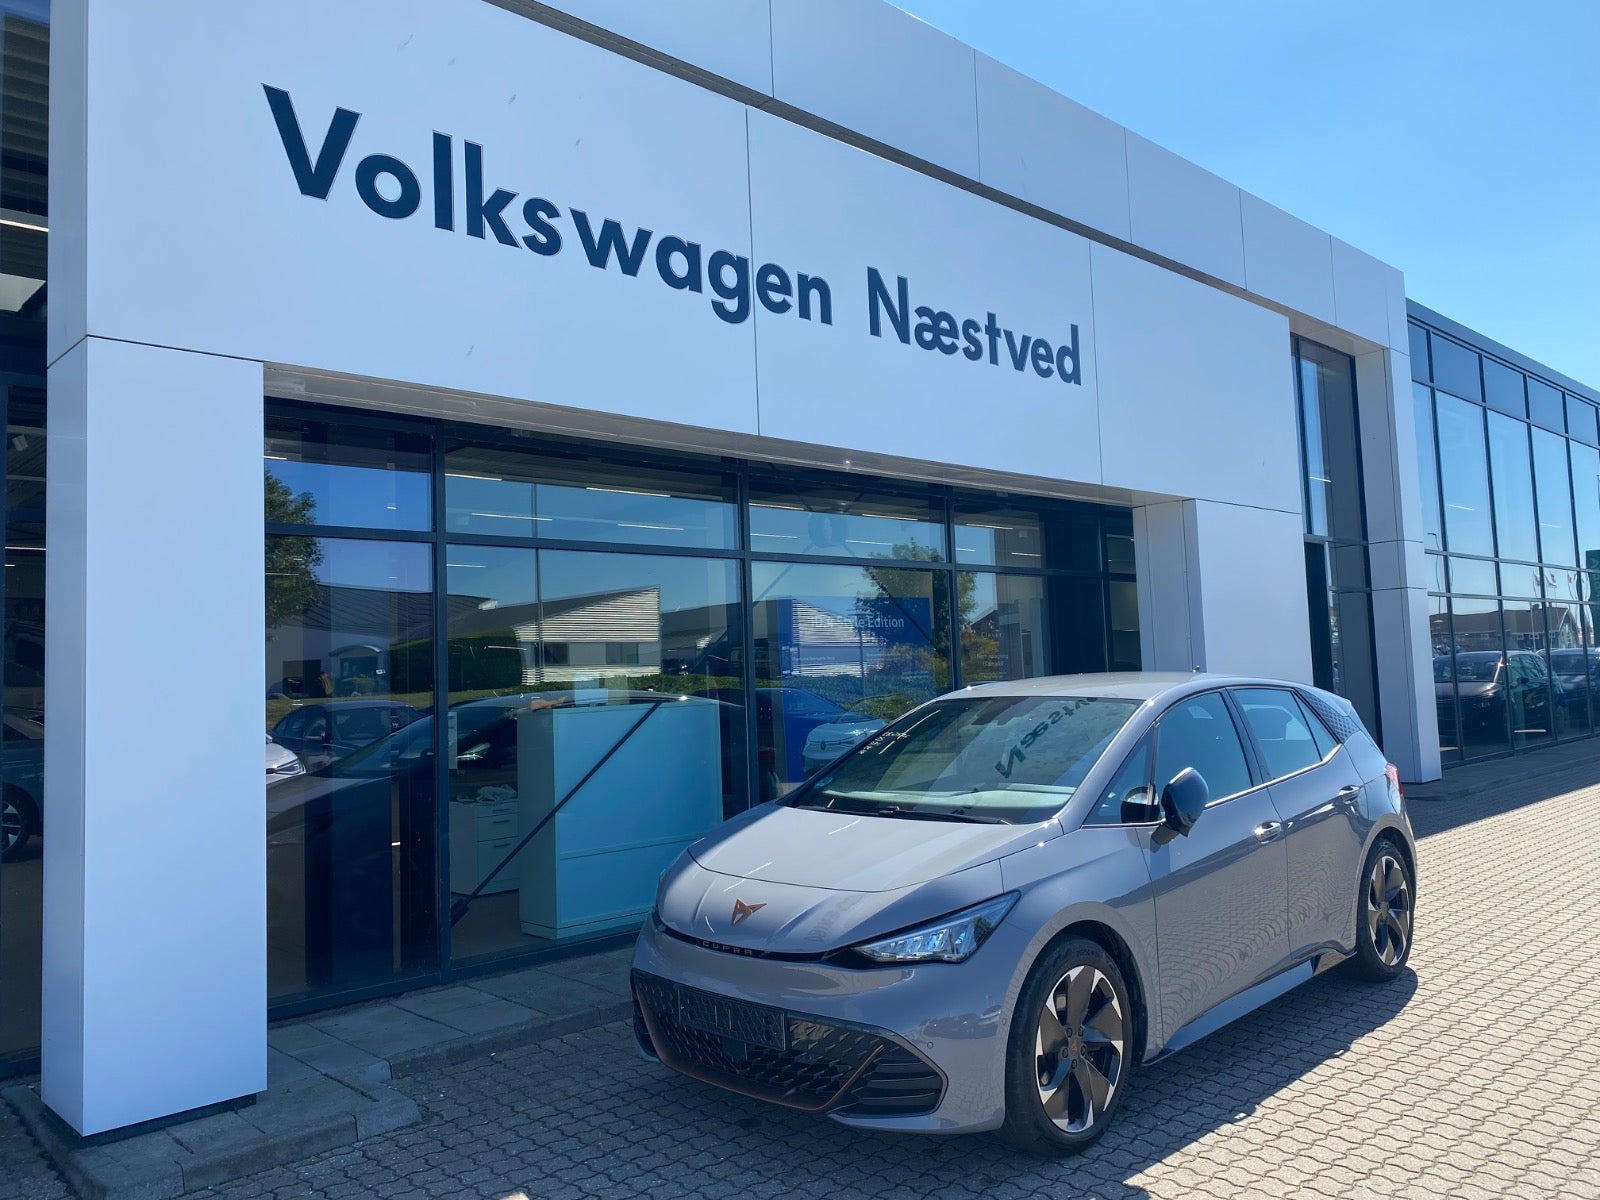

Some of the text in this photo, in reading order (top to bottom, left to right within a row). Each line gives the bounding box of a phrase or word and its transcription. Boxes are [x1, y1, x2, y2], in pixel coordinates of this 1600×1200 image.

[262, 83, 1083, 387] Volkswagen Næstved
[866, 614, 905, 629] Edition
[702, 941, 752, 955] CUPRA
